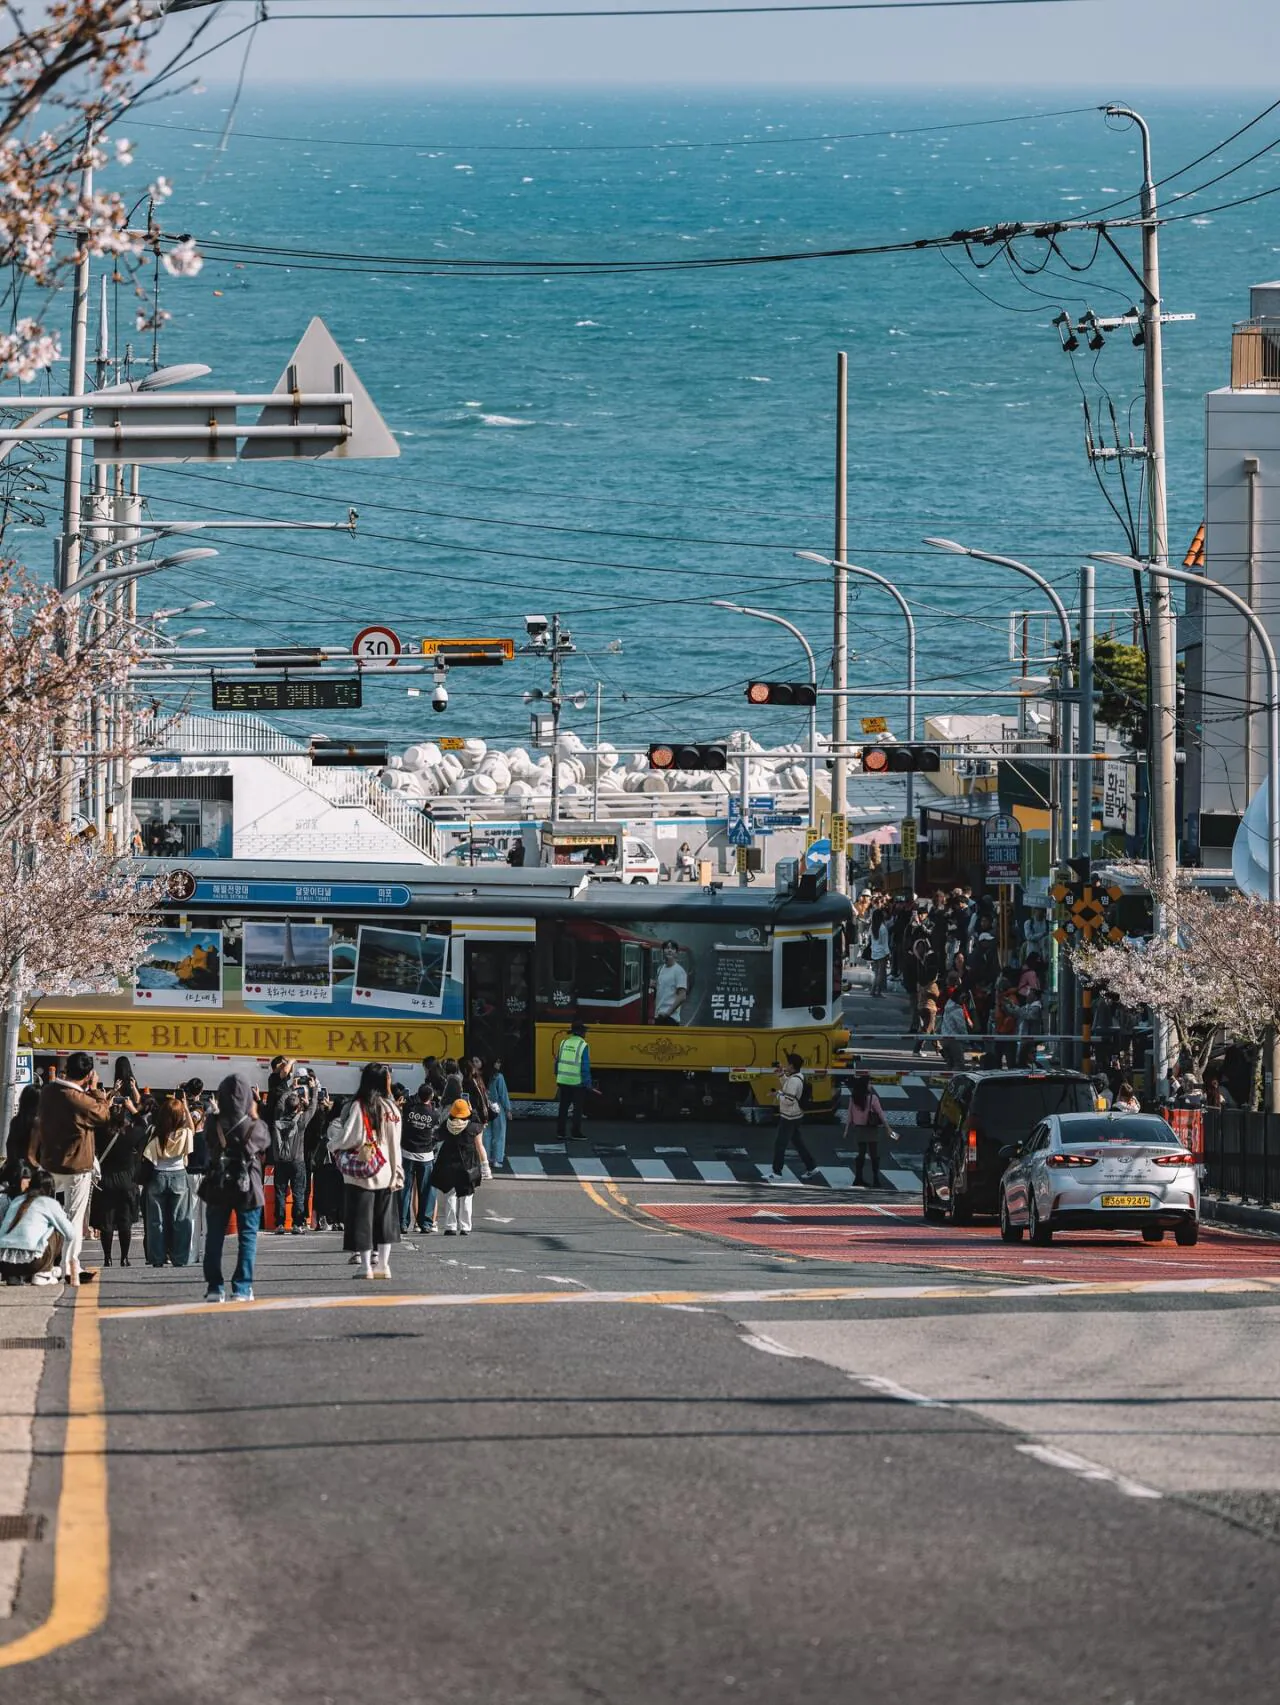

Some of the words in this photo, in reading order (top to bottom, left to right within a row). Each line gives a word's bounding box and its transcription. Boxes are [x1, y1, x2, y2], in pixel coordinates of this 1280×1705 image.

[364, 640, 389, 655] 30
[711, 994, 725, 1008] 또
[728, 994, 756, 1008] 만나
[713, 1008, 751, 1022] 대만!
[151, 1025, 303, 1051] BLUELINE
[327, 1030, 415, 1054] PARK
